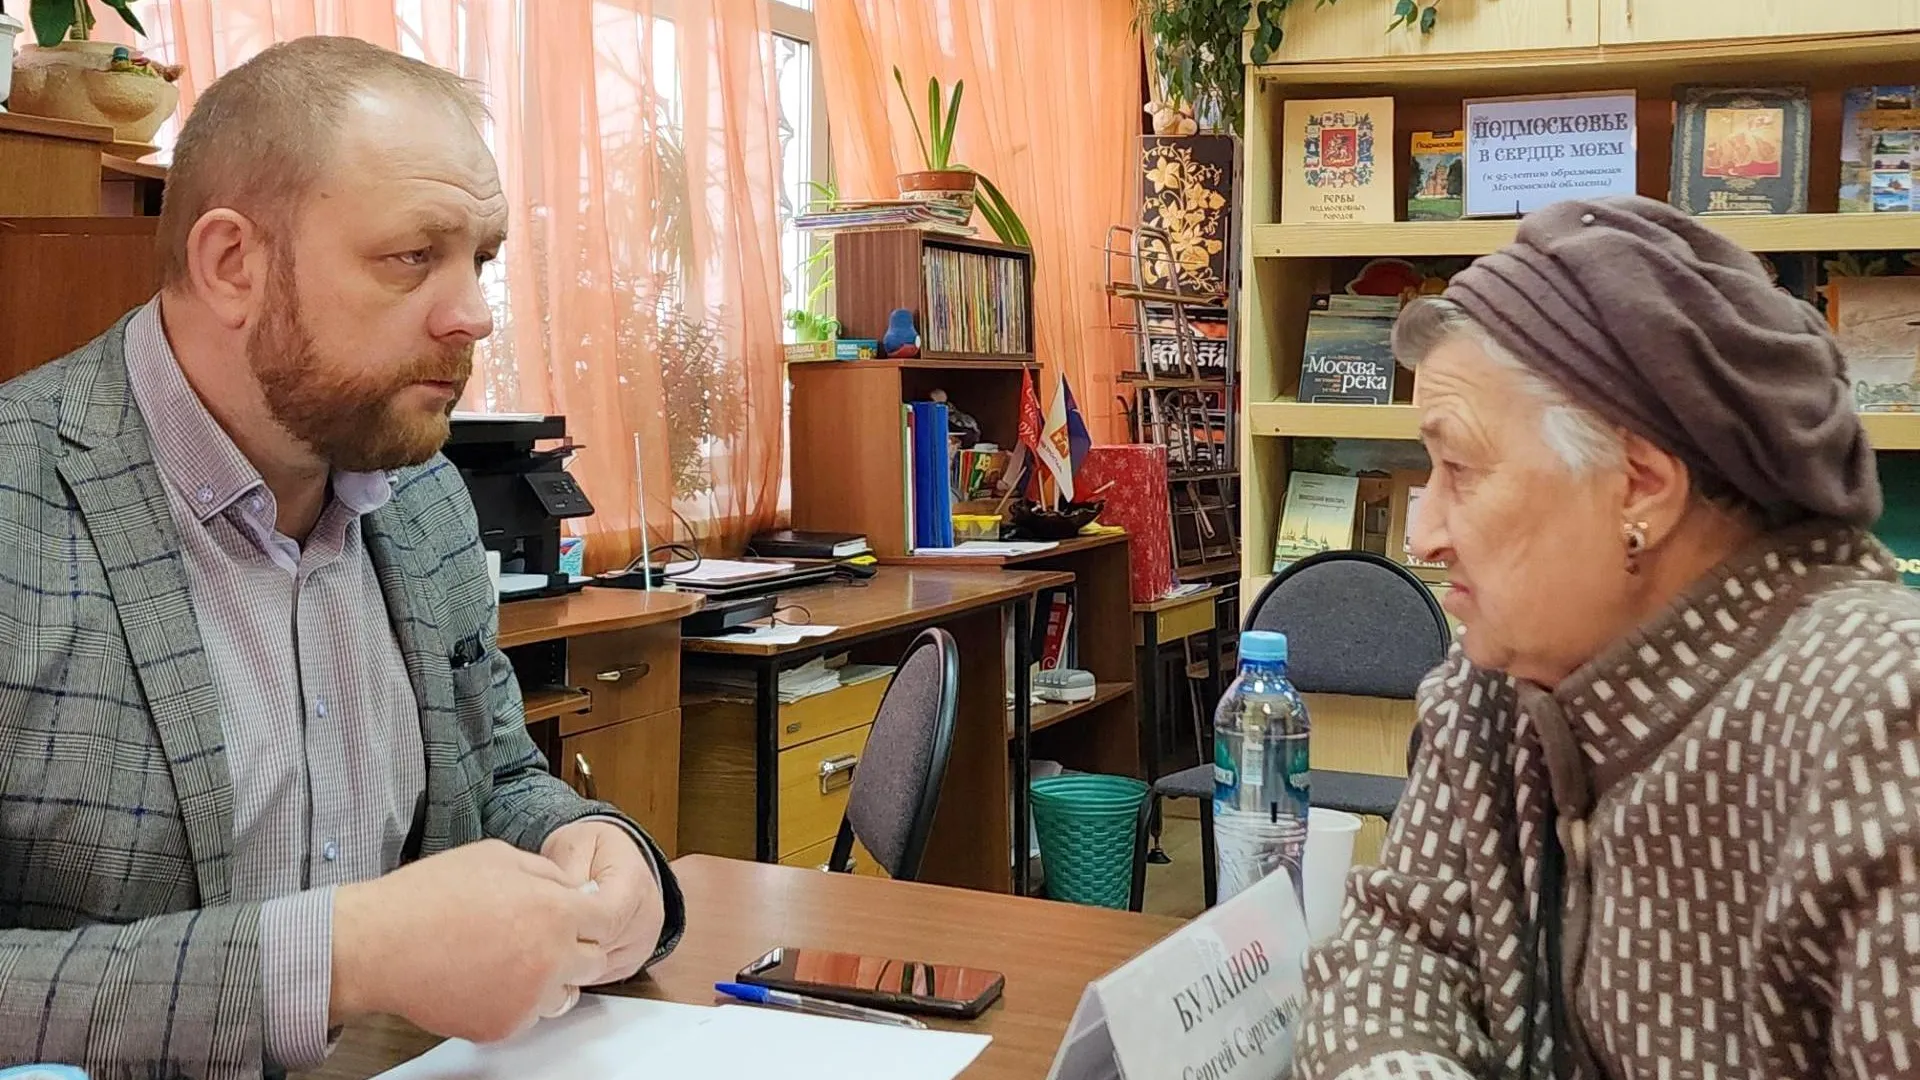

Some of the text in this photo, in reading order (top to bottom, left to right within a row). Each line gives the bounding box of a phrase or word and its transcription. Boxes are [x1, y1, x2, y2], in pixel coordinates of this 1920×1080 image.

[1473, 112, 1628, 142] ПОДМОСКОВЬЕ
[1479, 141, 1624, 163] В СЕРДЦЕ МОЕМ
[1482, 167, 1622, 182] (к 95-летию образования
[1492, 178, 1612, 192] Московской области)
[1323, 193, 1355, 203] ГЕРБЫ
[1307, 355, 1384, 375] Москва-
[1341, 374, 1387, 394] река
[1173, 940, 1270, 1033] БУЛАНОВ
[1233, 993, 1301, 1059] Сергеевич
